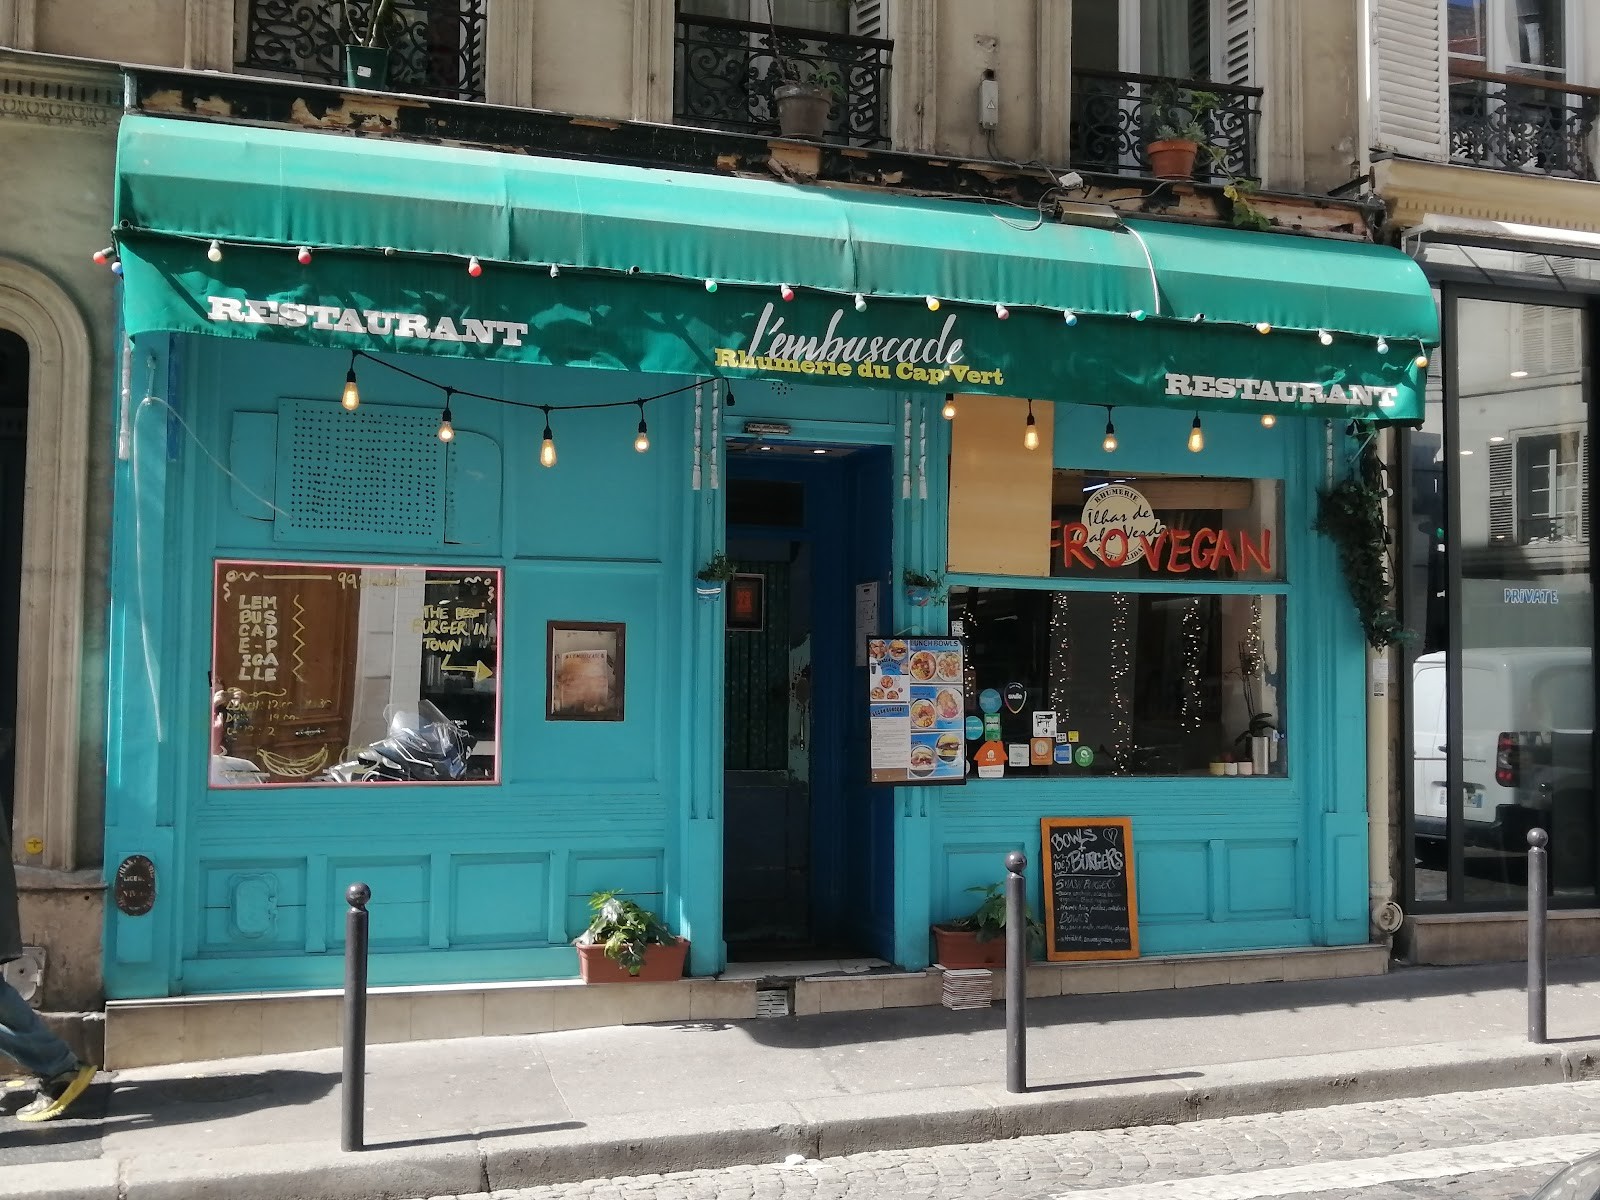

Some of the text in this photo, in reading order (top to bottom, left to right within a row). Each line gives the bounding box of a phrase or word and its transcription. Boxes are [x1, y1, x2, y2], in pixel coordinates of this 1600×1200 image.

[207, 296, 528, 347] RESTAURANT
[746, 302, 966, 365] l'embuscade
[714, 347, 852, 377] Rhumerie
[857, 358, 891, 380] du
[1164, 373, 1398, 407] RESTAURANT
[1094, 488, 1139, 504] RHUMERIE
[1133, 504, 1151, 520] de
[1139, 527, 1272, 573] VEGAN
[239, 609, 278, 625] BUS
[423, 604, 487, 620] THE BEST
[238, 623, 278, 639] CAD
[473, 622, 489, 636] IN
[422, 637, 462, 653] TOWN
[1051, 828, 1098, 852] BOWLS
[1067, 847, 1124, 873] BURGERS
